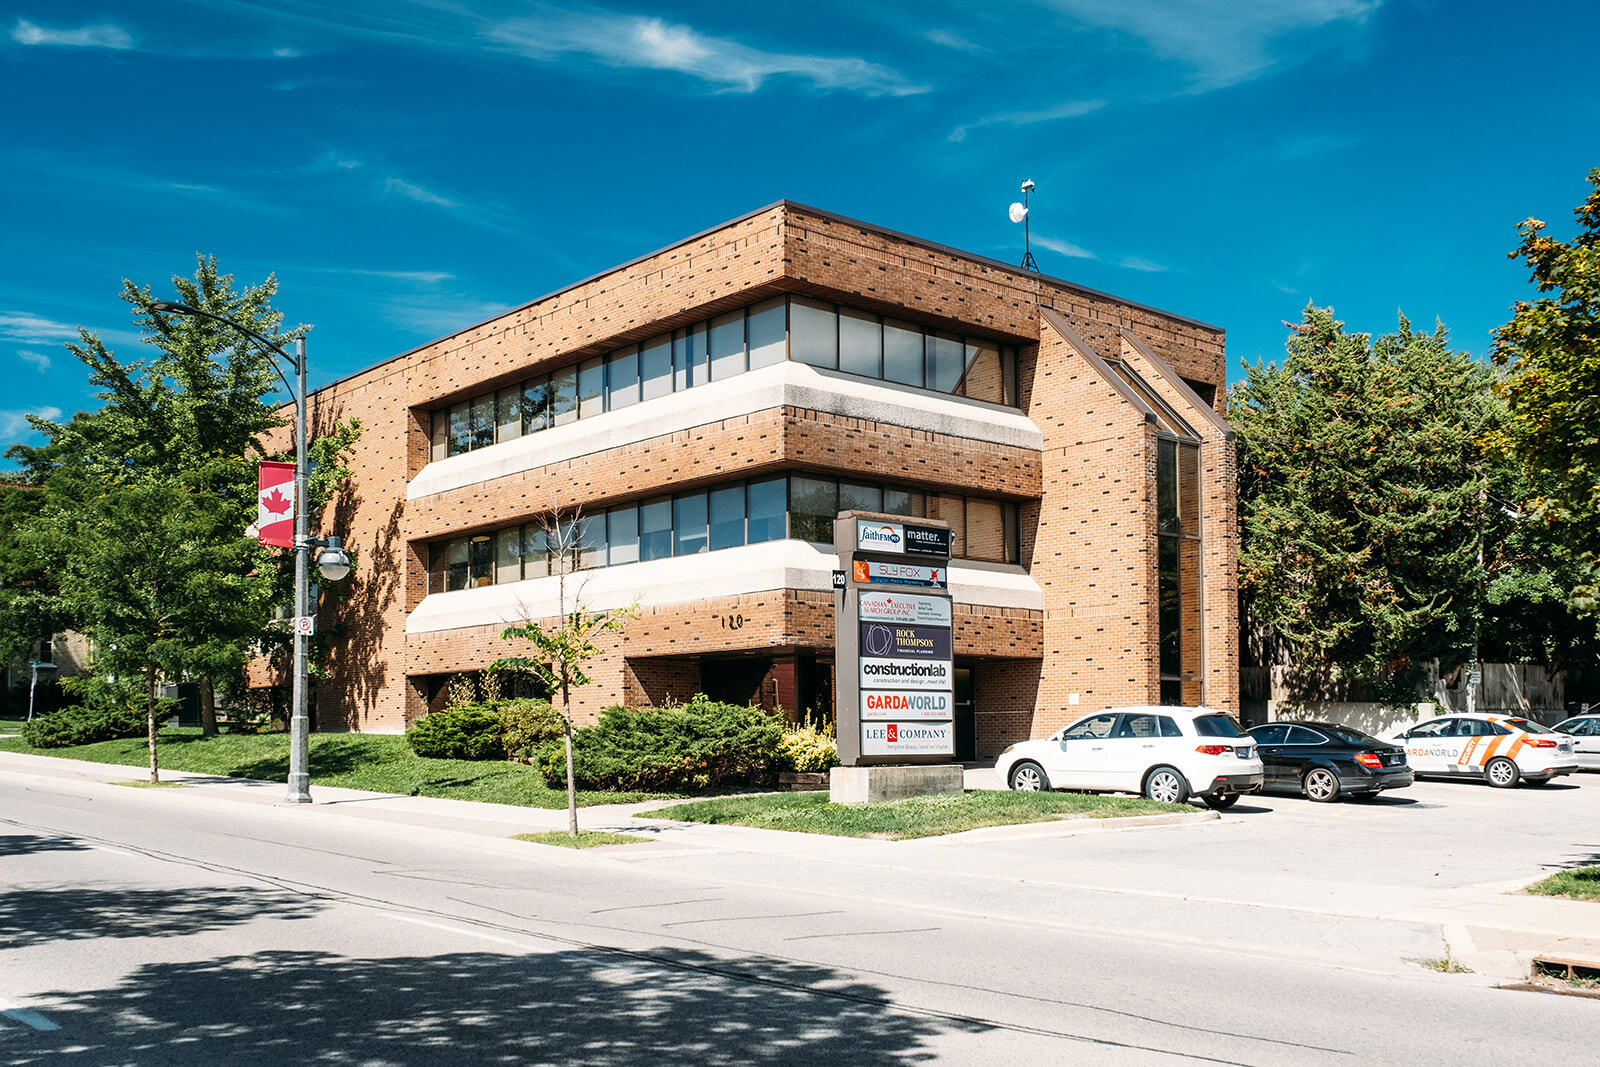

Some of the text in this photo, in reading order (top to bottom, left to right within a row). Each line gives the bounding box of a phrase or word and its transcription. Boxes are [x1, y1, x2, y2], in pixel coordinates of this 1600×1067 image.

[907, 530, 940, 542] matter.
[879, 564, 920, 578] SLY FOX
[832, 573, 845, 585] 120
[884, 608, 901, 616] GROUP
[721, 614, 743, 630] 120
[896, 629, 915, 638] ROCK
[896, 638, 934, 647] THOMPSON
[864, 663, 946, 677] constructionlab
[867, 695, 946, 710] GARDAWORLD
[866, 728, 946, 739] LEE & COMPANY
[1406, 748, 1459, 757] ARDAWORLD
